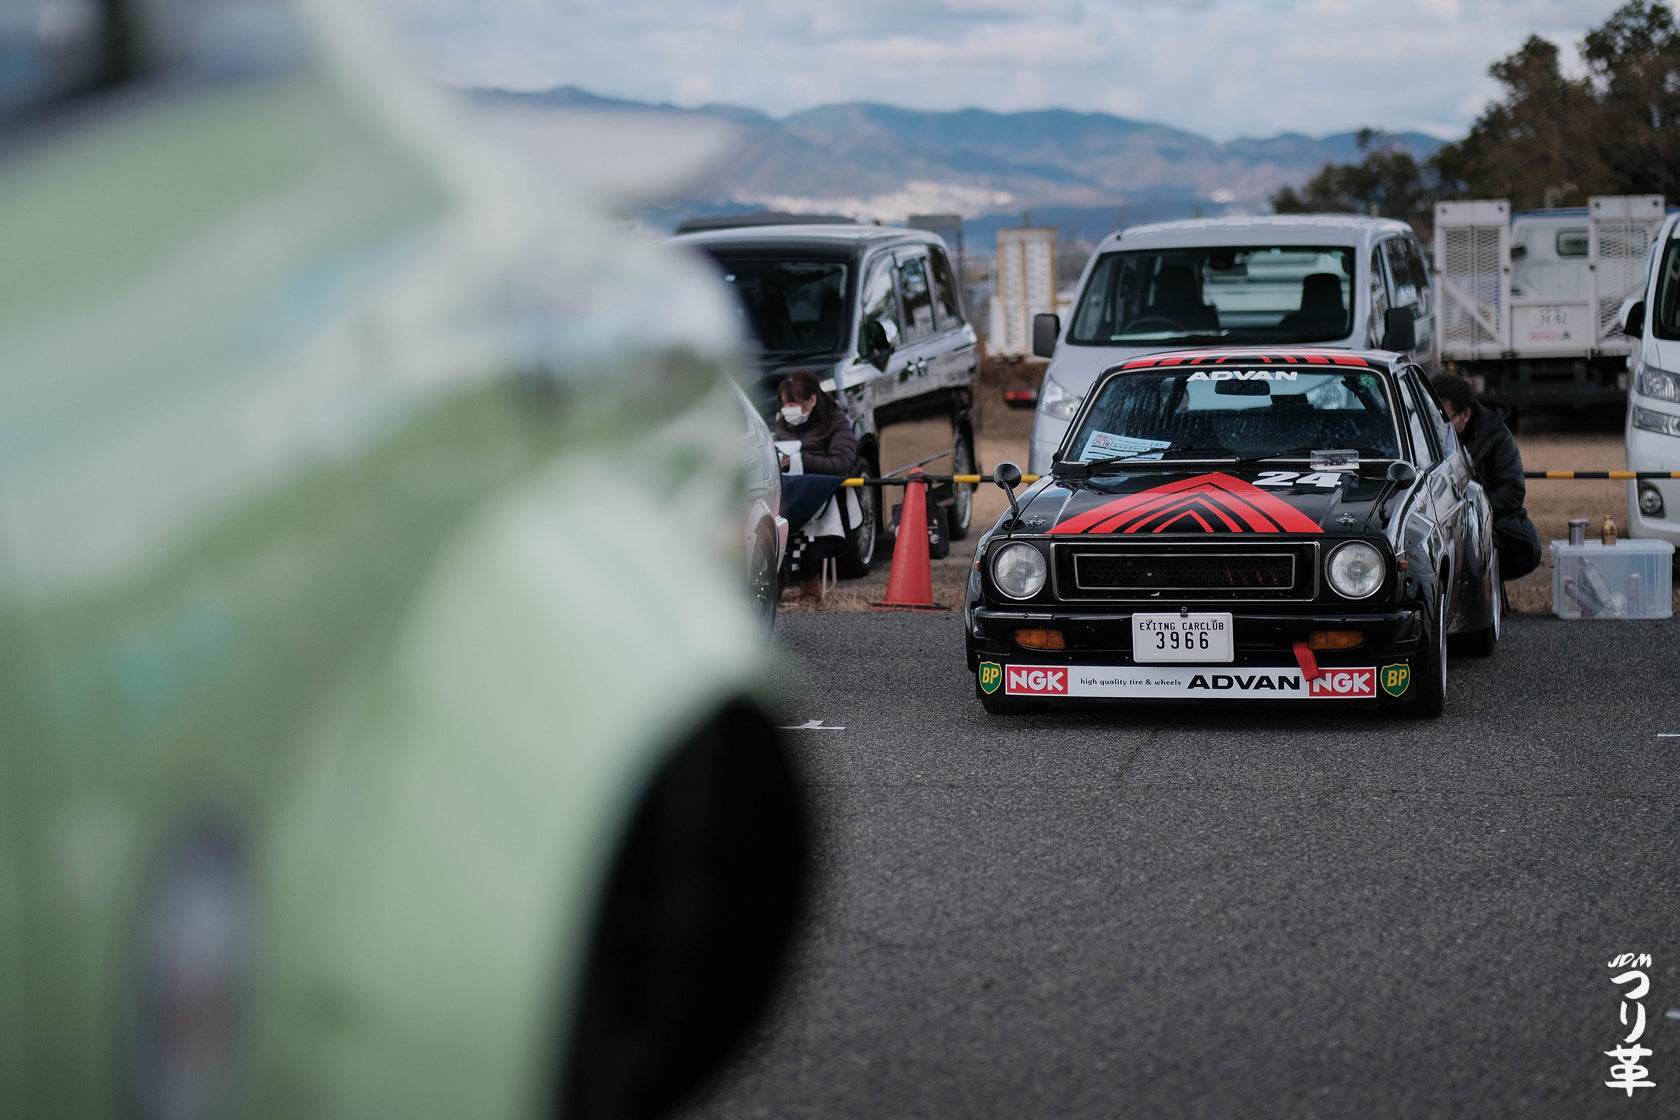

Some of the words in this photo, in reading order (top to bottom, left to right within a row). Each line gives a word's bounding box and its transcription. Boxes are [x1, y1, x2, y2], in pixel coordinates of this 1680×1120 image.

[1186, 371, 1298, 381] ADVAN
[1251, 471, 1342, 488] 24
[1139, 622, 1176, 631] EXITNG
[1182, 622, 1224, 631] CARCLUB
[1155, 631, 1209, 650] 3966
[982, 667, 999, 683] BP
[1009, 670, 1065, 692] NGK
[1080, 678, 1098, 687] high
[1099, 678, 1128, 687] quality
[1129, 678, 1143, 686] tire
[1187, 675, 1300, 690] ADVAN
[1312, 672, 1371, 693] NGK
[1387, 669, 1407, 686] BP
